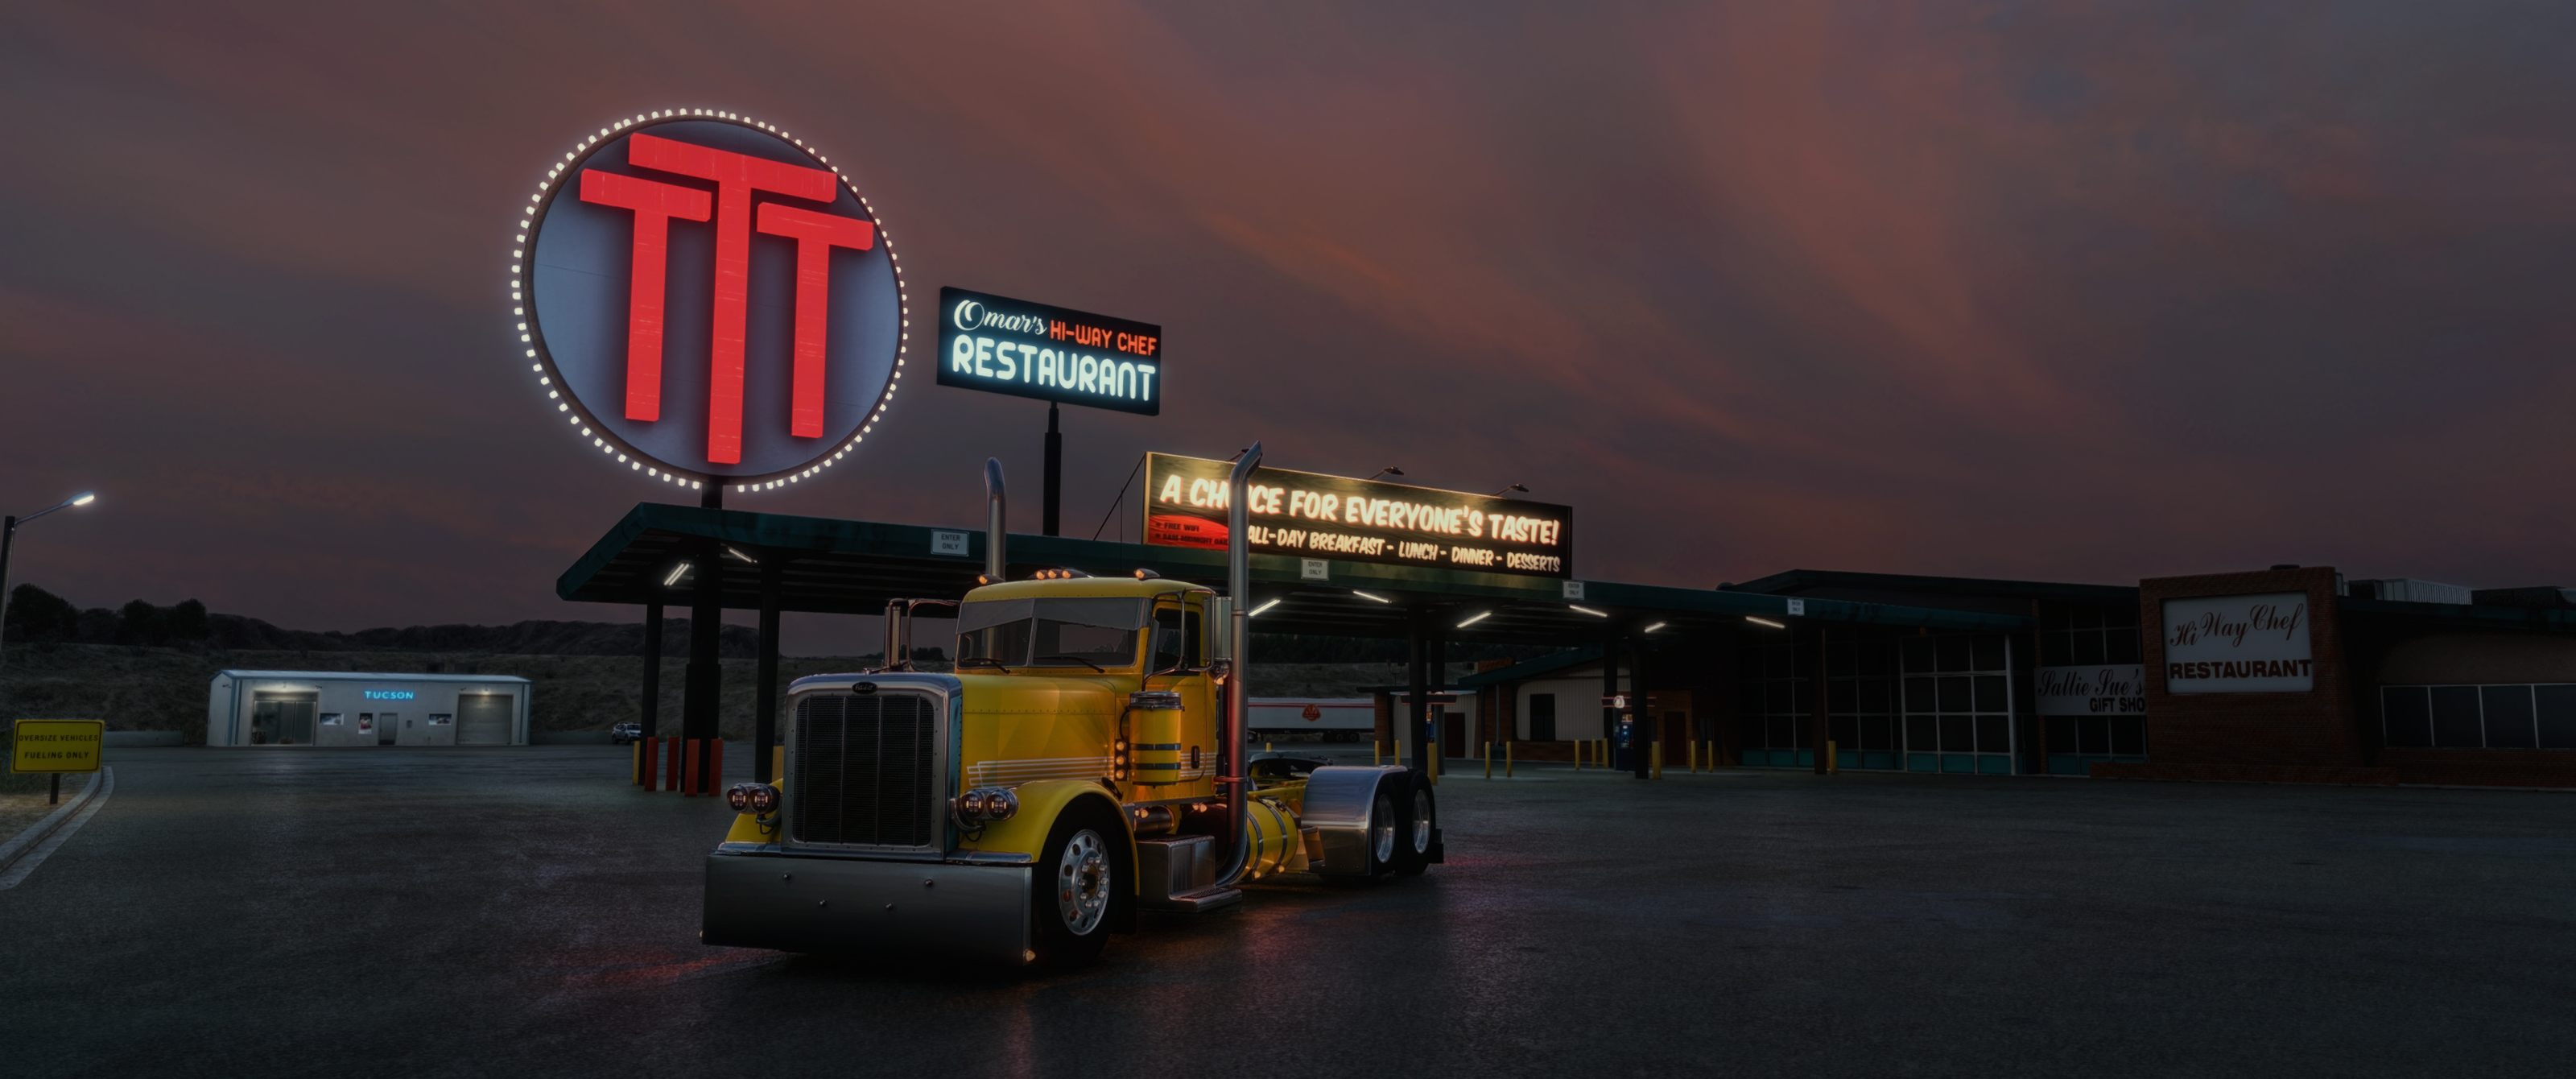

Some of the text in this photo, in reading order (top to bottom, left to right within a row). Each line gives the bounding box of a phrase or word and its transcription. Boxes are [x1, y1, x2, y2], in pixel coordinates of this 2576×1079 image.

[580, 132, 874, 465] TTT
[954, 300, 1158, 356] Omar's HI-WAY CHEF
[952, 334, 1156, 402] RESTAURANT
[1159, 474, 1561, 547] A CHCE FOR EVERYONE'S TASTE!
[1164, 522, 1181, 530] FREE
[1248, 524, 1307, 548] ALL-DAY
[1309, 531, 1385, 556] BREAKFAST
[1398, 540, 1439, 561] LUNCH
[1451, 546, 1494, 567] DINNER
[1506, 552, 1561, 573] DESSERTS
[2170, 603, 2304, 647] Hi Way Chef
[2038, 670, 2093, 697] Sallie
[2169, 659, 2312, 679] RESTAURANT
[364, 690, 415, 700] TUCSON
[2089, 697, 2116, 713] GIFT
